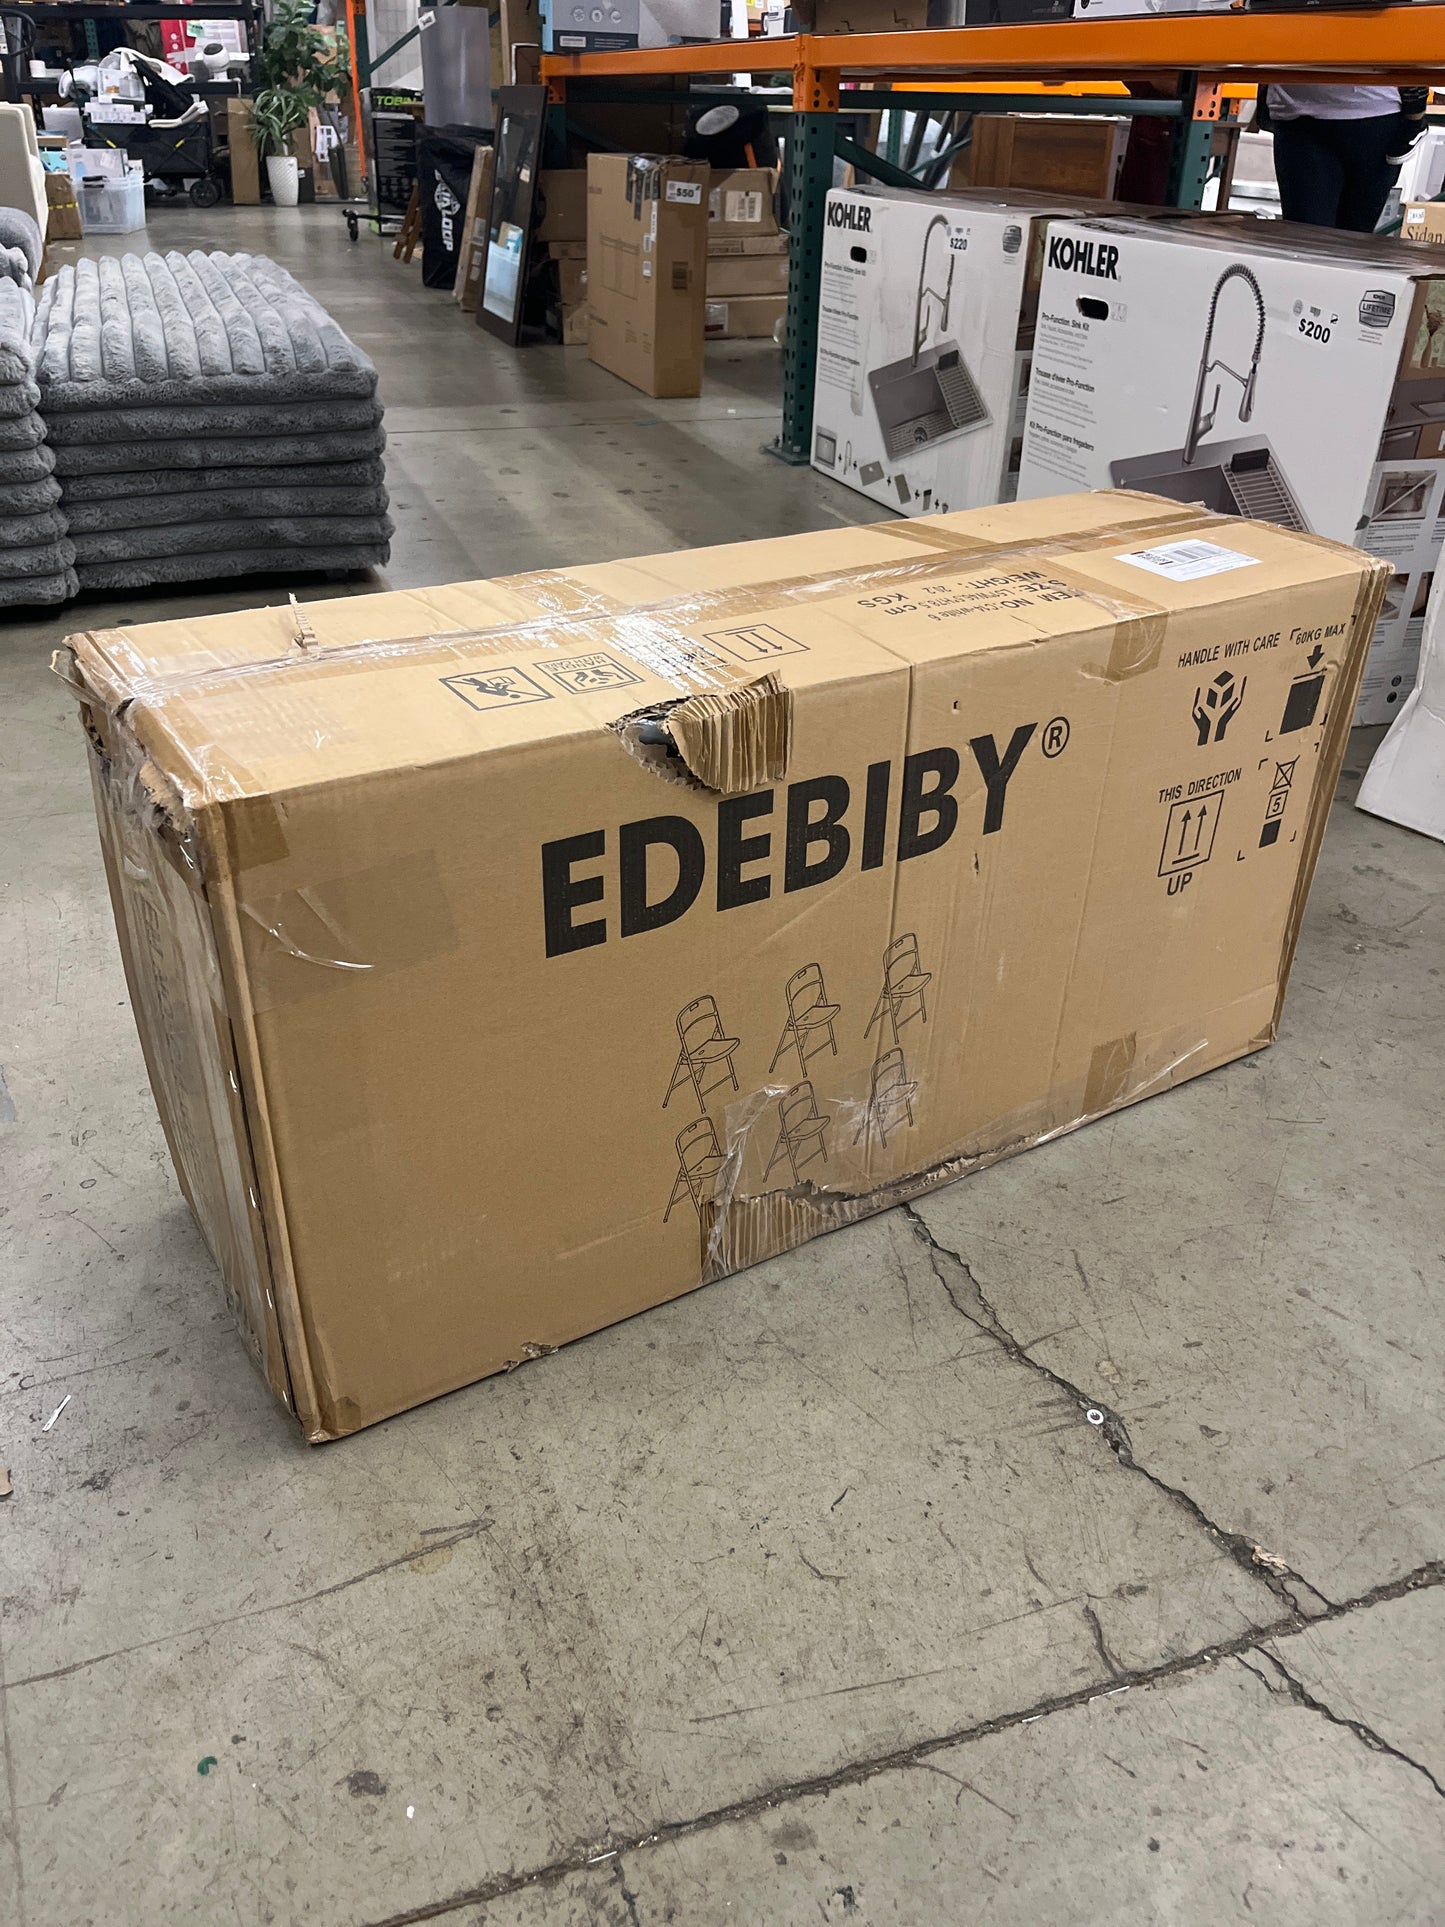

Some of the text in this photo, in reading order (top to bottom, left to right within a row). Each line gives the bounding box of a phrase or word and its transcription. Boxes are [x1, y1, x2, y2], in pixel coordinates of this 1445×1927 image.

[676, 188, 694, 198] $50
[827, 201, 872, 232] KOHLER
[950, 237, 968, 251] $220
[1048, 236, 1119, 281] KOHLER
[1362, 303, 1392, 316] LIFETIME
[1298, 318, 1331, 344] $200
[1018, 579, 1067, 594] SZE:
[858, 592, 909, 609] KGS
[884, 604, 917, 616] cm
[1295, 623, 1346, 646] 60KG MAX
[1178, 632, 1281, 668] HANDLE WITH CARE
[1159, 768, 1242, 804] THIS DIRECTION
[1272, 797, 1282, 813] 5
[1166, 872, 1193, 896] UP
